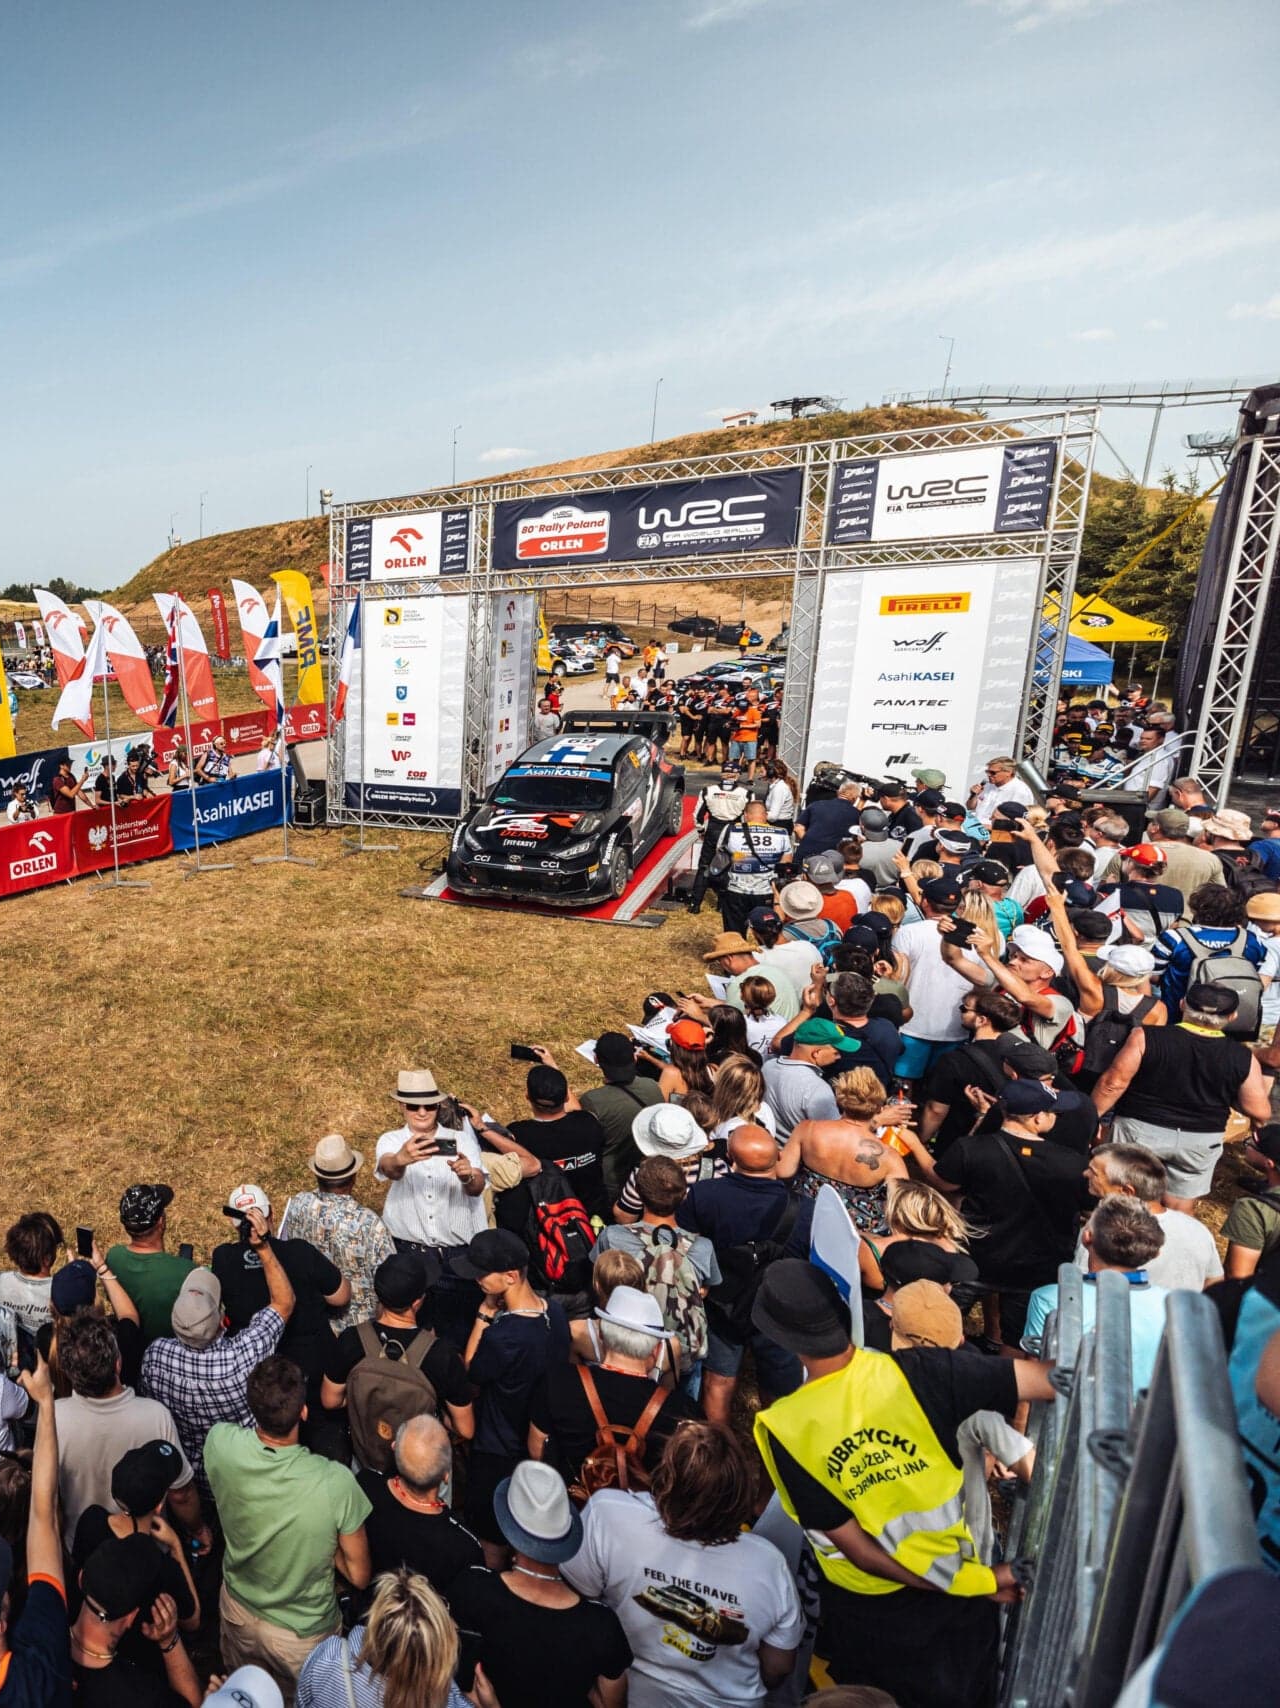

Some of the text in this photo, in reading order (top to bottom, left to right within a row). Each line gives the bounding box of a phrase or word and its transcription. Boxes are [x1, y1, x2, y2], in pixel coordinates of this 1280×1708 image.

[887, 475, 989, 500] WRC
[638, 494, 767, 530] WRC
[887, 505, 902, 513] FIA
[538, 521, 564, 535] Rally
[566, 518, 605, 530] Poland
[540, 538, 583, 551] ORLEN
[638, 534, 661, 549] FIA
[384, 556, 427, 569] ORLEN
[888, 596, 962, 612] PIRELLI
[878, 672, 955, 682] AsahiKASEI
[873, 699, 952, 707] FANATEC
[871, 723, 948, 732] FORUM8
[391, 749, 412, 762] WP
[524, 768, 592, 779] AsahiKASEI
[192, 789, 274, 826] AsahiKASEI
[109, 831, 130, 841] Sortu
[499, 830, 549, 839] DENSO
[13, 855, 54, 876] ORLEN
[843, 1458, 929, 1502] FORMACYJNA
[644, 1567, 741, 1606] FEEL THE GRAVEL
